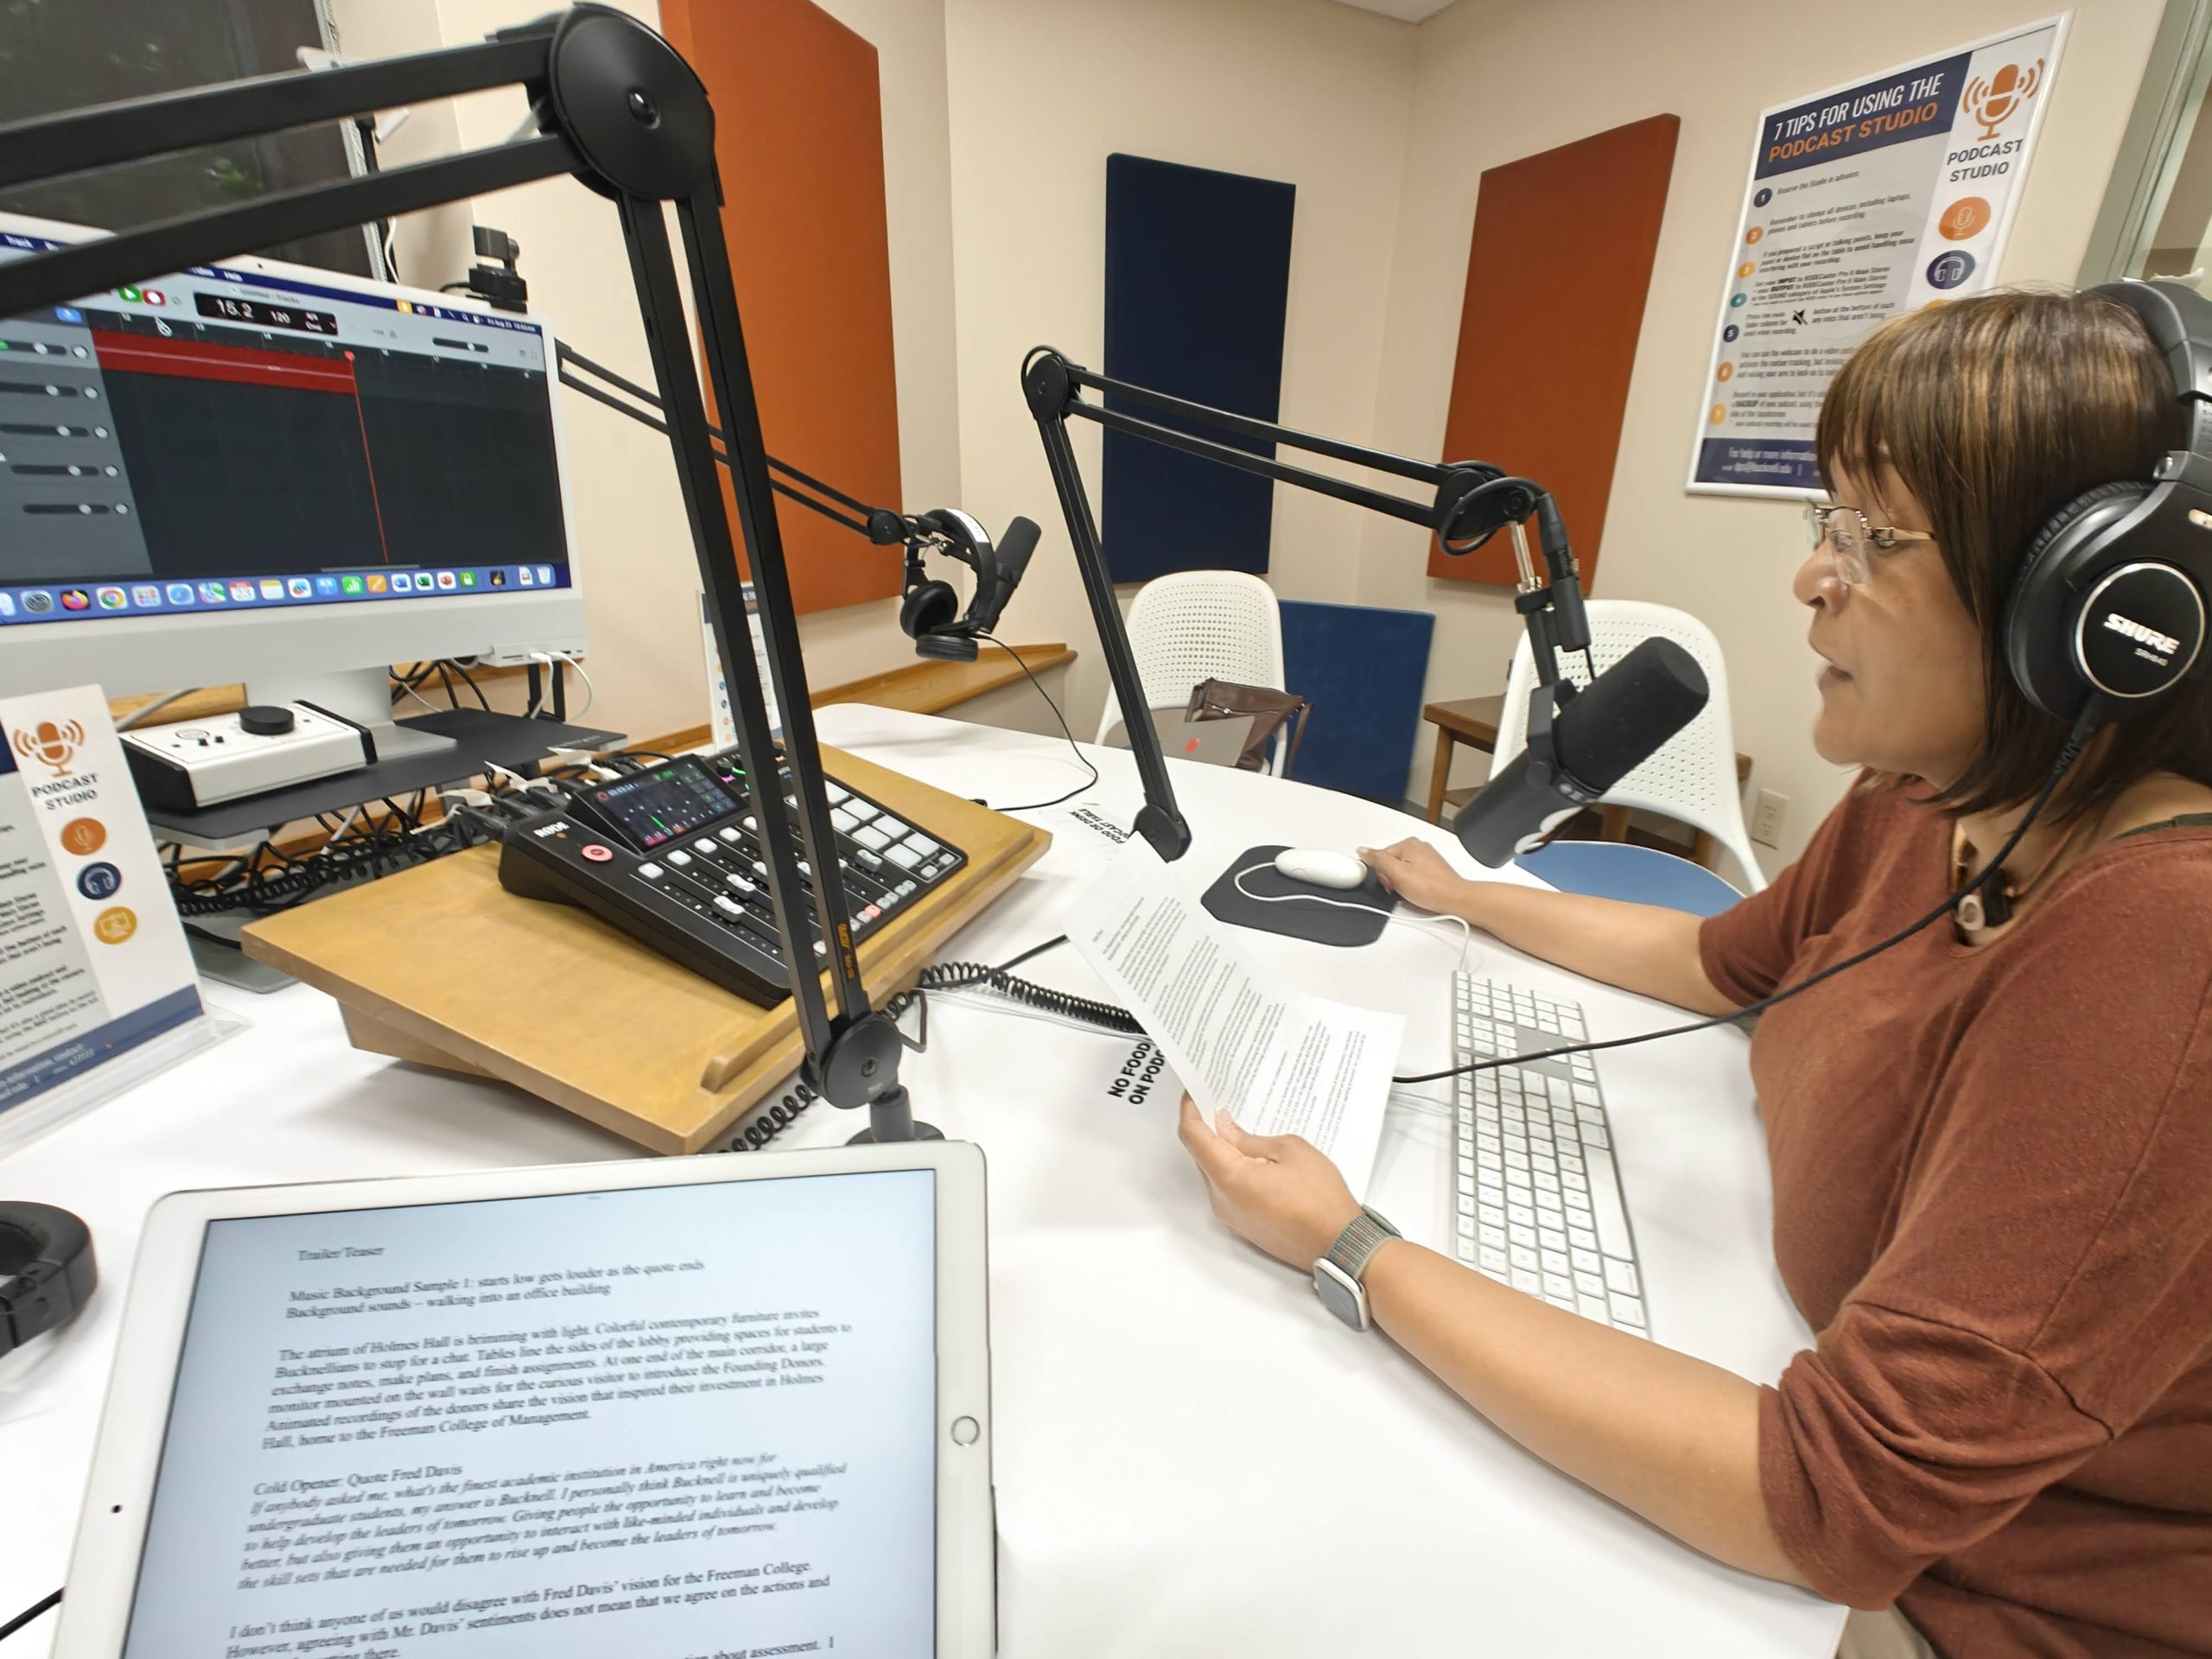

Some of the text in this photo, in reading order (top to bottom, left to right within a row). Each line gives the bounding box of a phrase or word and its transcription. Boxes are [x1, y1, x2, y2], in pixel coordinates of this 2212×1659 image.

[1773, 73, 1945, 142] 7 TIPS FOR USING THE
[1768, 103, 1939, 163] PODCAST STUDIO
[1947, 139, 2024, 166] PODCAST
[1809, 178, 1827, 188] Studio
[1948, 162, 2010, 182] STUDIO
[1806, 210, 1826, 219] silence
[1859, 198, 1886, 208] including
[2101, 613, 2181, 656] SHURE
[31, 772, 99, 799] PODCAST
[44, 787, 99, 811] STUDIO
[1106, 1042, 1152, 1098] NO FOOD
[1128, 1084, 1152, 1105] ON
[297, 1247, 385, 1261] Trailer Teaser
[289, 1291, 330, 1301] Music
[332, 1283, 411, 1299] Background
[412, 1280, 461, 1293] Sample
[477, 1277, 512, 1287] starts
[512, 1274, 536, 1284] low
[537, 1274, 564, 1285] gets
[564, 1268, 605, 1280] louder
[620, 1265, 643, 1274] the
[640, 1264, 677, 1275] quote
[677, 1262, 706, 1270] ends
[285, 1303, 366, 1319] Background
[366, 1300, 413, 1312] sounds
[425, 1295, 477, 1306] walking
[478, 1294, 505, 1303] into
[522, 1287, 560, 1299] office
[560, 1284, 613, 1296] building
[252, 1482, 289, 1495] Cold
[346, 1474, 389, 1487] Quote
[390, 1467, 423, 1481] Fred
[423, 1466, 464, 1478] Davis
[246, 1515, 347, 1532] undergraduate
[410, 1506, 431, 1516] my
[433, 1501, 481, 1512] answer
[483, 1499, 496, 1508] is
[568, 1483, 635, 1501] personally
[637, 1480, 669, 1491] think
[671, 1474, 725, 1488] Bucknell
[727, 1476, 738, 1484] is
[740, 1468, 792, 1483] uniquely
[792, 1463, 848, 1479] qualified
[278, 1618, 315, 1632] think
[317, 1615, 368, 1630] anyone
[369, 1609, 386, 1622] of
[387, 1611, 405, 1619] us
[406, 1601, 451, 1617] would
[451, 1598, 508, 1612] disagree
[510, 1591, 541, 1604] with
[542, 1587, 575, 1600] Fred
[620, 1580, 660, 1591] vision
[661, 1575, 682, 1586] for
[683, 1573, 704, 1584] the
[705, 1568, 761, 1581] Freeman
[296, 1636, 355, 1652] agreeing
[359, 1628, 390, 1641] with
[466, 1612, 537, 1629] sentiments
[538, 1608, 571, 1620] does
[571, 1605, 595, 1616] not
[596, 1602, 633, 1612] mean
[633, 1597, 660, 1608] that
[683, 1592, 719, 1605] agree
[739, 1585, 760, 1595] the
[761, 1581, 805, 1593] actions
[807, 1575, 831, 1588] and
